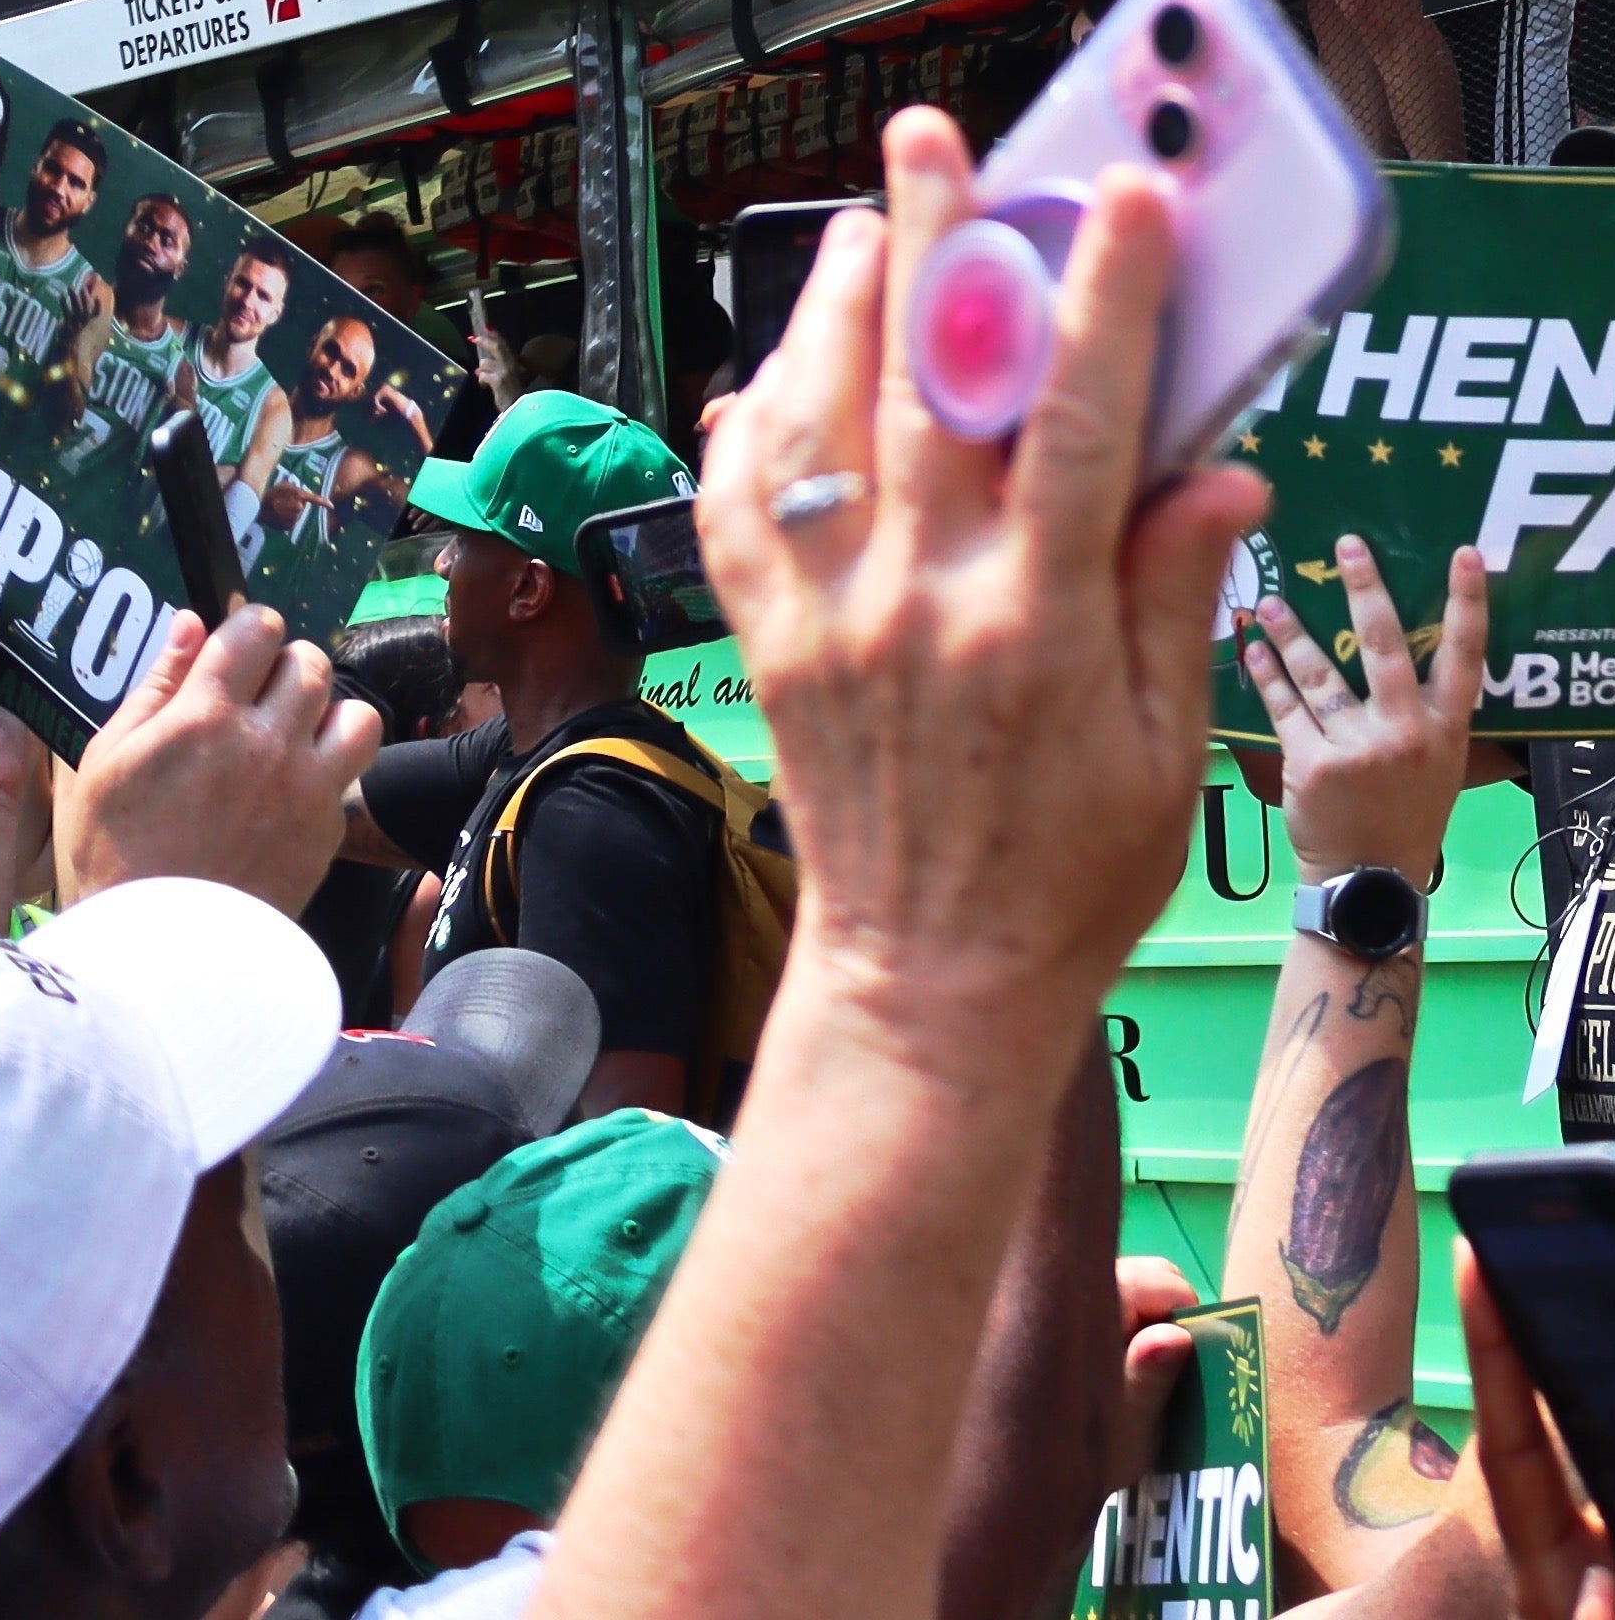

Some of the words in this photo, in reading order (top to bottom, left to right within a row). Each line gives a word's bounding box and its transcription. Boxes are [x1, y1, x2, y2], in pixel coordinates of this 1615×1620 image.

[119, 9, 251, 72] DEPARTURES
[88, 350, 157, 436] STON
[1248, 531, 1280, 592] ELTI
